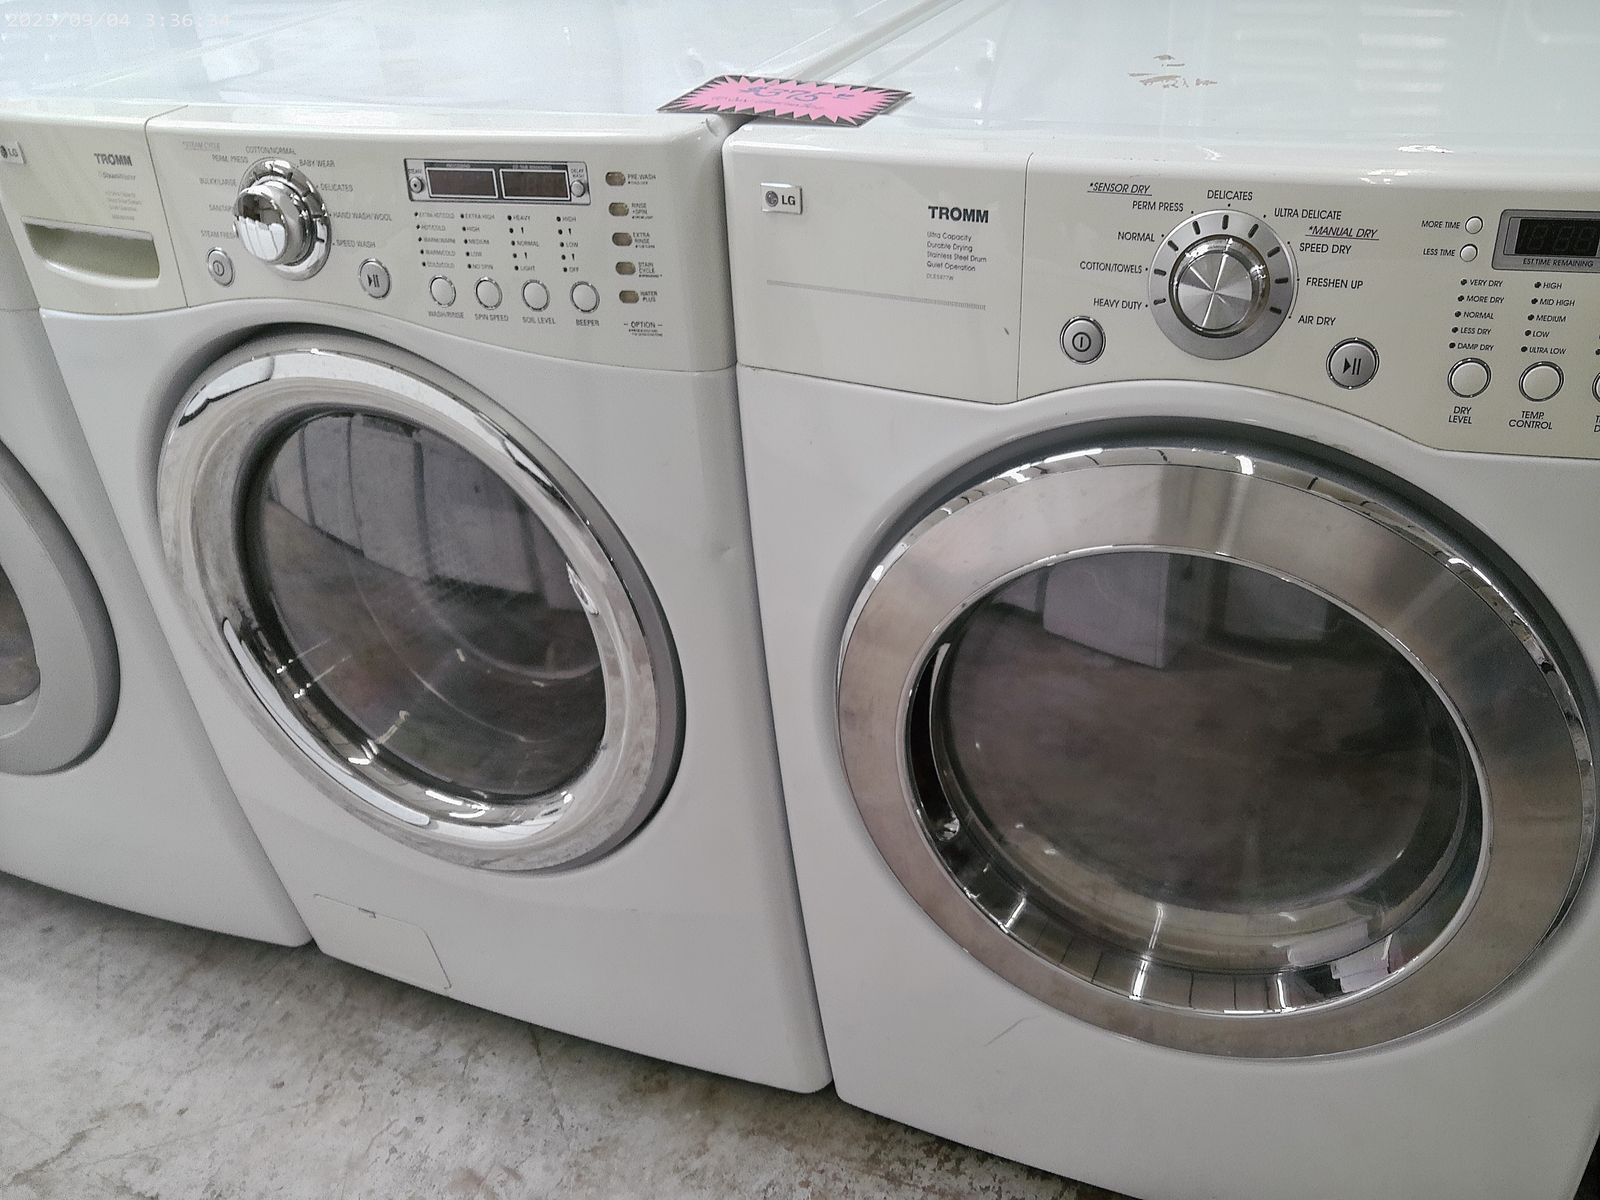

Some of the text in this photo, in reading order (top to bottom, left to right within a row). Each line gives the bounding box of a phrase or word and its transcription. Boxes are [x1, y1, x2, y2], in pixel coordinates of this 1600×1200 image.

[245, 145, 297, 156] COTTON/NORMAL
[94, 152, 133, 166] TROMM
[230, 155, 249, 164] PRESS
[299, 159, 336, 168] BABY WEAR
[320, 183, 354, 192] DELICATES
[1130, 185, 1151, 194] DRY
[1207, 190, 1253, 200] DELICATES
[781, 194, 796, 206] LG
[1132, 200, 1184, 212] PERM PRESS
[333, 212, 351, 220] HAND
[512, 214, 531, 222] HEAVY
[928, 206, 990, 224] TROMM
[1274, 208, 1342, 220] ULTRA DELICATE
[1421, 220, 1461, 229] MORE TIME
[926, 231, 972, 243] Ultra Capacity
[1118, 232, 1155, 242] NORMAL
[1356, 228, 1378, 239] DRY
[336, 240, 376, 248] SPEED WASH
[926, 240, 973, 253] Durable Drying
[1299, 242, 1352, 255] SPEED DRY
[927, 251, 987, 263] Stainless Steel Drum
[1423, 248, 1455, 257] LESS TIME
[926, 260, 976, 272] Quiet Operation
[1535, 258, 1551, 266] TIME
[1552, 259, 1594, 267] REMAINING
[1080, 261, 1142, 274] COTTON/TOWELS
[1306, 277, 1364, 290] FRESHEN UP
[1470, 279, 1503, 288] VERY DRY
[1543, 282, 1562, 290] HIGH
[1093, 298, 1142, 310] HEAVY DUTY
[1489, 296, 1504, 304] DRY
[1556, 299, 1575, 307] HIGH
[428, 311, 464, 319] WASH/RINSE
[474, 313, 509, 322] SPIN SPEED
[1464, 311, 1494, 320] NORMAL
[1536, 315, 1567, 323] MEDIUM
[522, 316, 556, 325] SOIL LEVEL
[576, 319, 600, 327] BEEPER
[1298, 315, 1336, 326] AIR DRY
[1460, 327, 1476, 335] LESS
[1532, 330, 1550, 338] LOW
[1457, 343, 1494, 352] DAMP DRY
[1529, 346, 1549, 354] ULTRA
[1453, 406, 1472, 415] DRY
[1448, 415, 1472, 424] LEVEL
[1521, 411, 1544, 420] TEMP.
[1508, 419, 1553, 430] CONTROL
